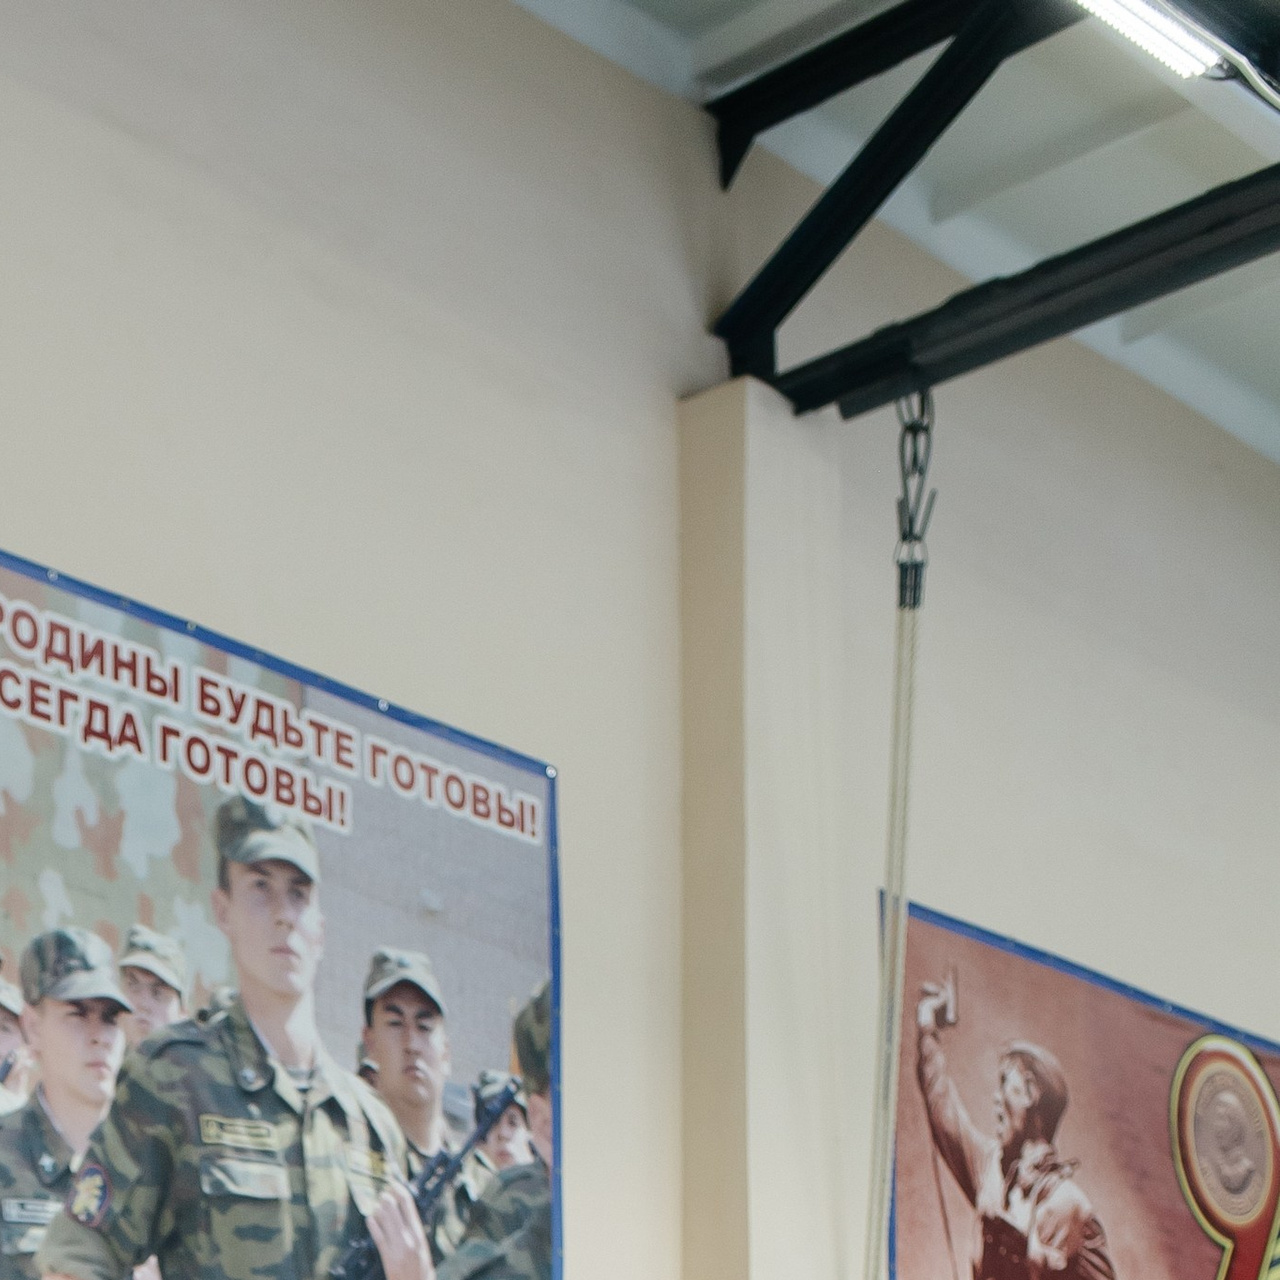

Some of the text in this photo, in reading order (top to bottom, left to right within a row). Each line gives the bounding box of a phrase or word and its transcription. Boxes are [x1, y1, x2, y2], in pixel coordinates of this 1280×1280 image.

[160, 725, 348, 827] ГОТОВЫ!
[198, 675, 355, 771] БУДЬТЕ
[369, 742, 538, 838] ГОТОВЫ!
